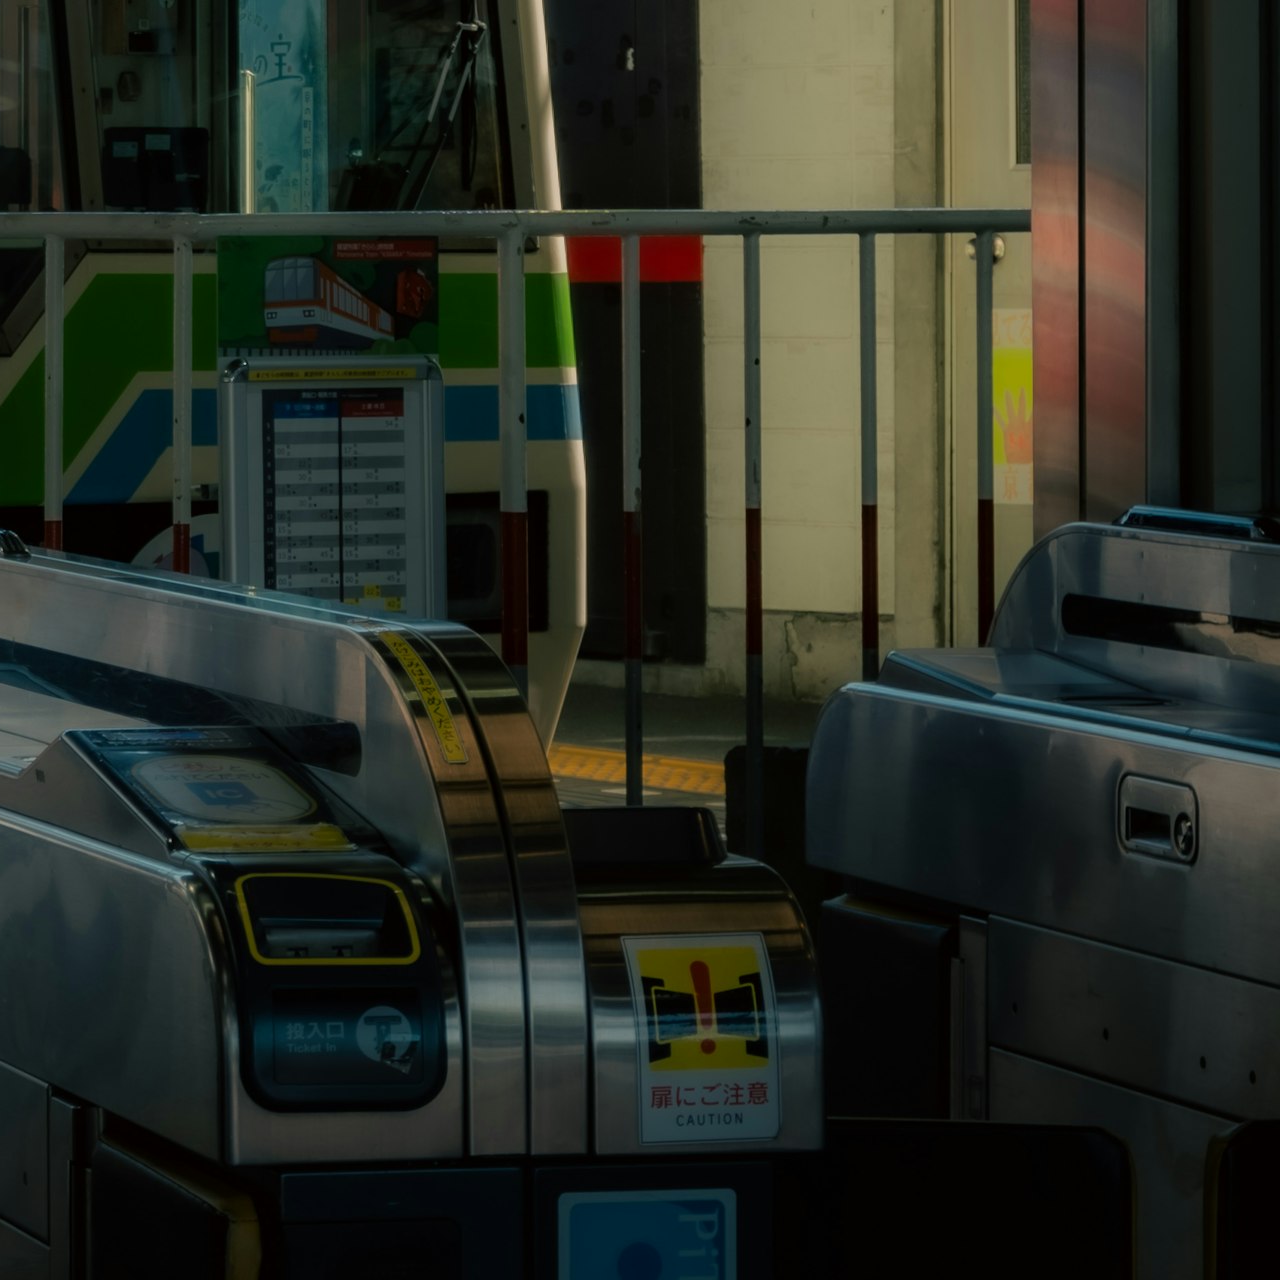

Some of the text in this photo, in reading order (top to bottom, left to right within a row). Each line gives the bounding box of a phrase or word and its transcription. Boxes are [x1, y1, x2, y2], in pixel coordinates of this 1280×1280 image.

[285, 1022, 344, 1040] 投入口
[287, 1043, 337, 1053] Ticket In
[650, 1082, 769, 1109] 扉にご注意
[675, 1113, 744, 1127] CAUTION
